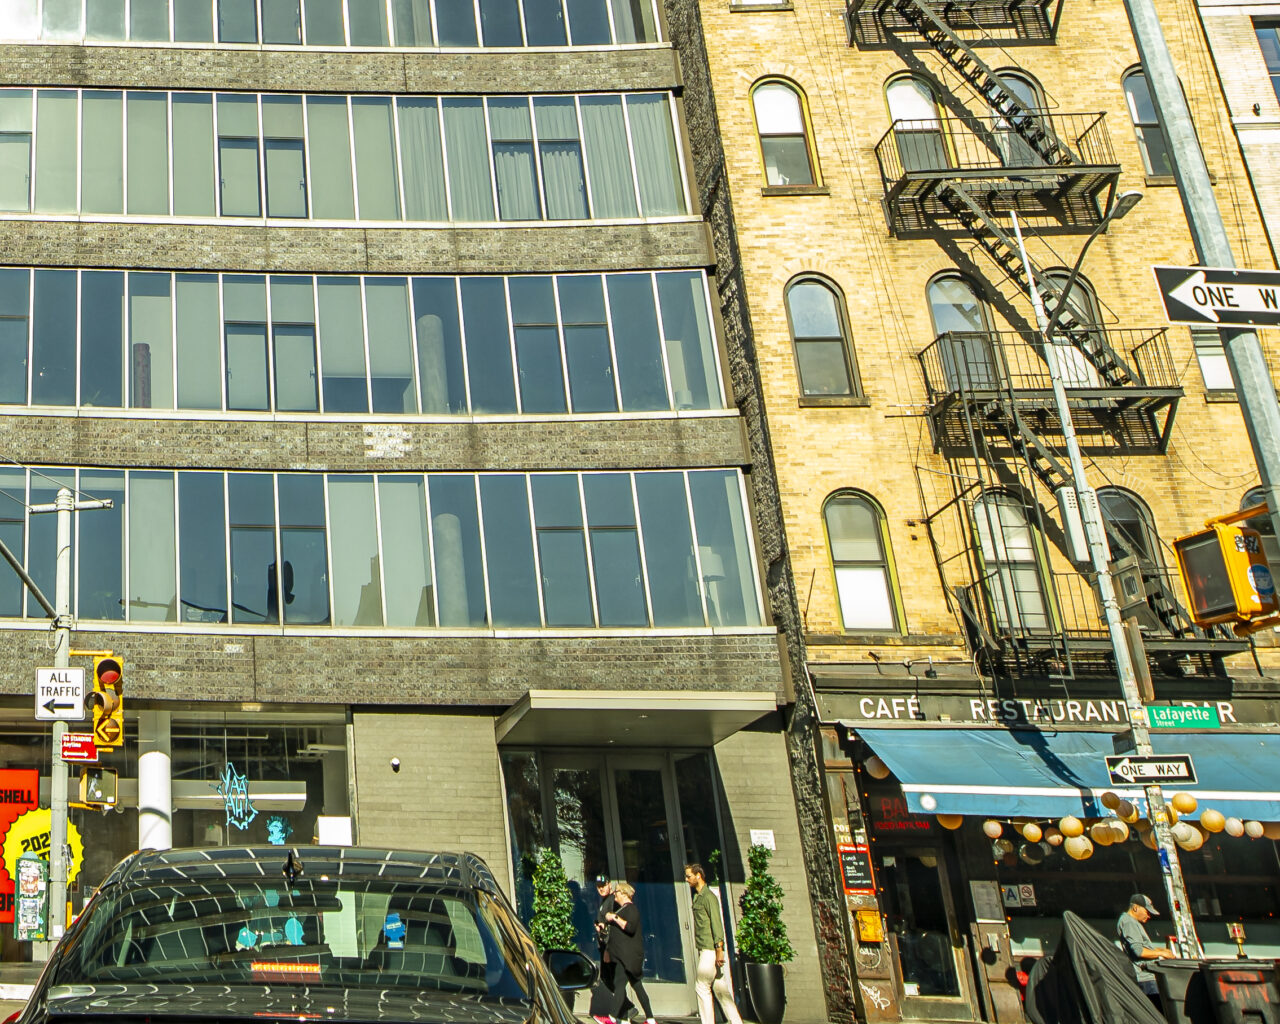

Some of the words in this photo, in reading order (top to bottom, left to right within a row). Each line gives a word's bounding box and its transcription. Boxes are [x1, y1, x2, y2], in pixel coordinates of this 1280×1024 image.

[1192, 286, 1240, 307] ONE
[50, 672, 71, 683] ALL
[41, 687, 80, 696] TRAFFIC
[859, 695, 922, 719] CAFÉ
[1152, 708, 1210, 723] Lafayette
[1121, 764, 1146, 776] ONE
[1156, 764, 1180, 774] WAY
[21, 831, 51, 852] 202
[1007, 888, 1017, 901] A
